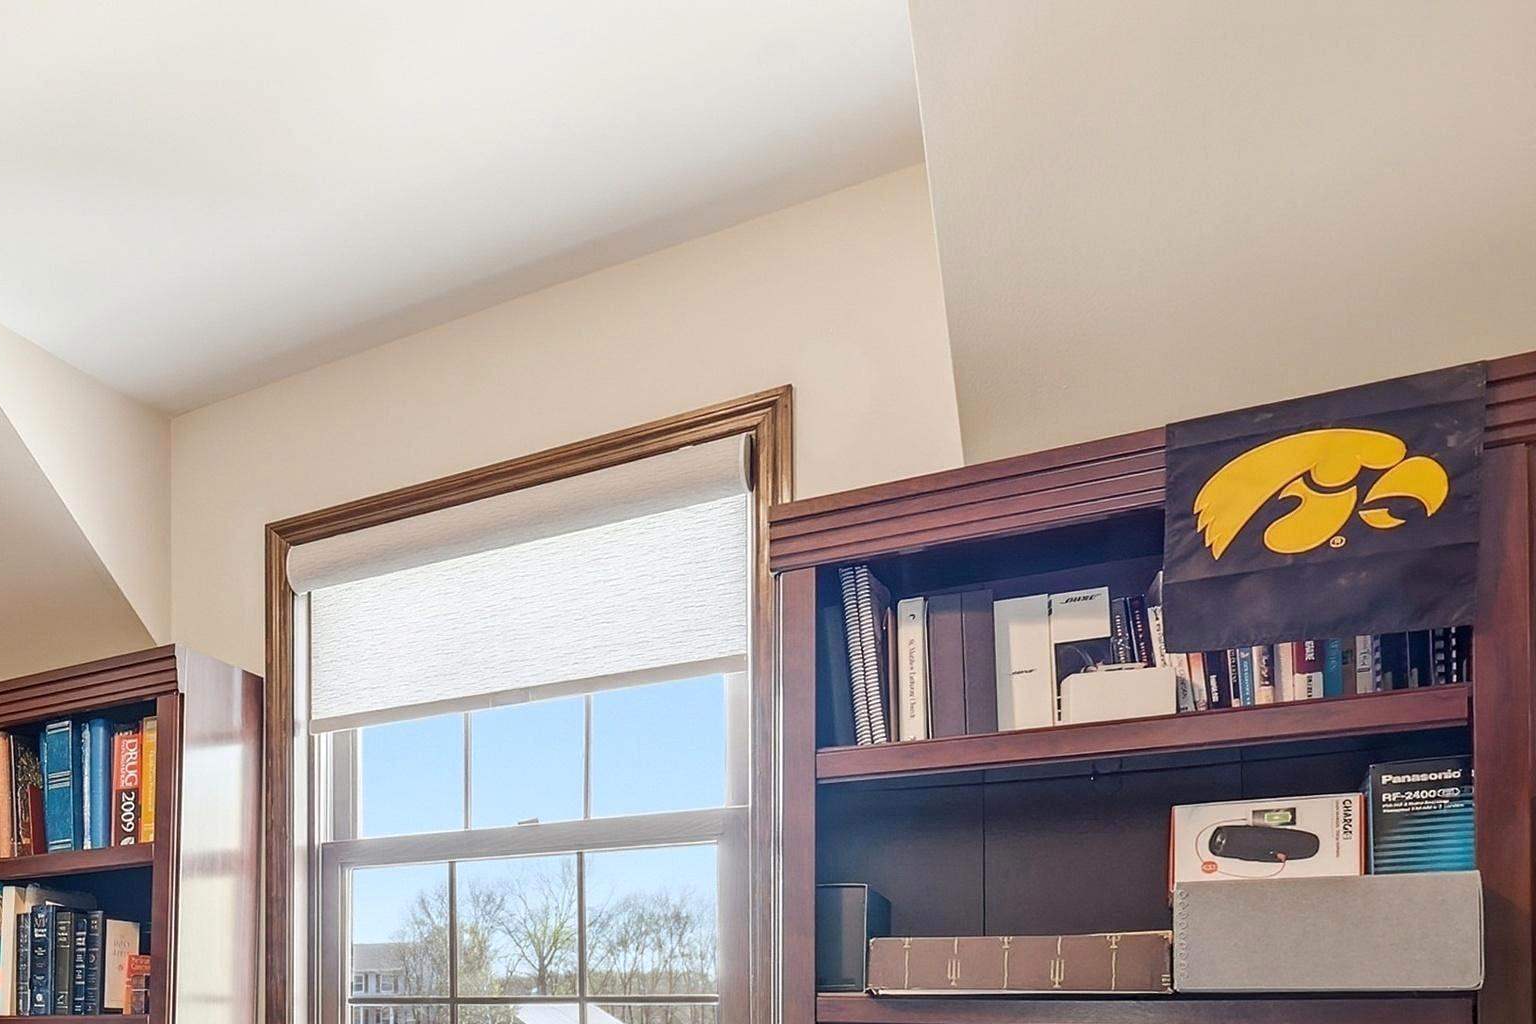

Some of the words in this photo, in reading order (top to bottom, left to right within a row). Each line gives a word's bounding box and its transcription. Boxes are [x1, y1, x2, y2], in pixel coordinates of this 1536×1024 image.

[123, 739, 138, 787] DRUG
[1381, 769, 1461, 785] Panasonic
[1382, 789, 1436, 802] RF-2400
[120, 791, 136, 832] 2009
